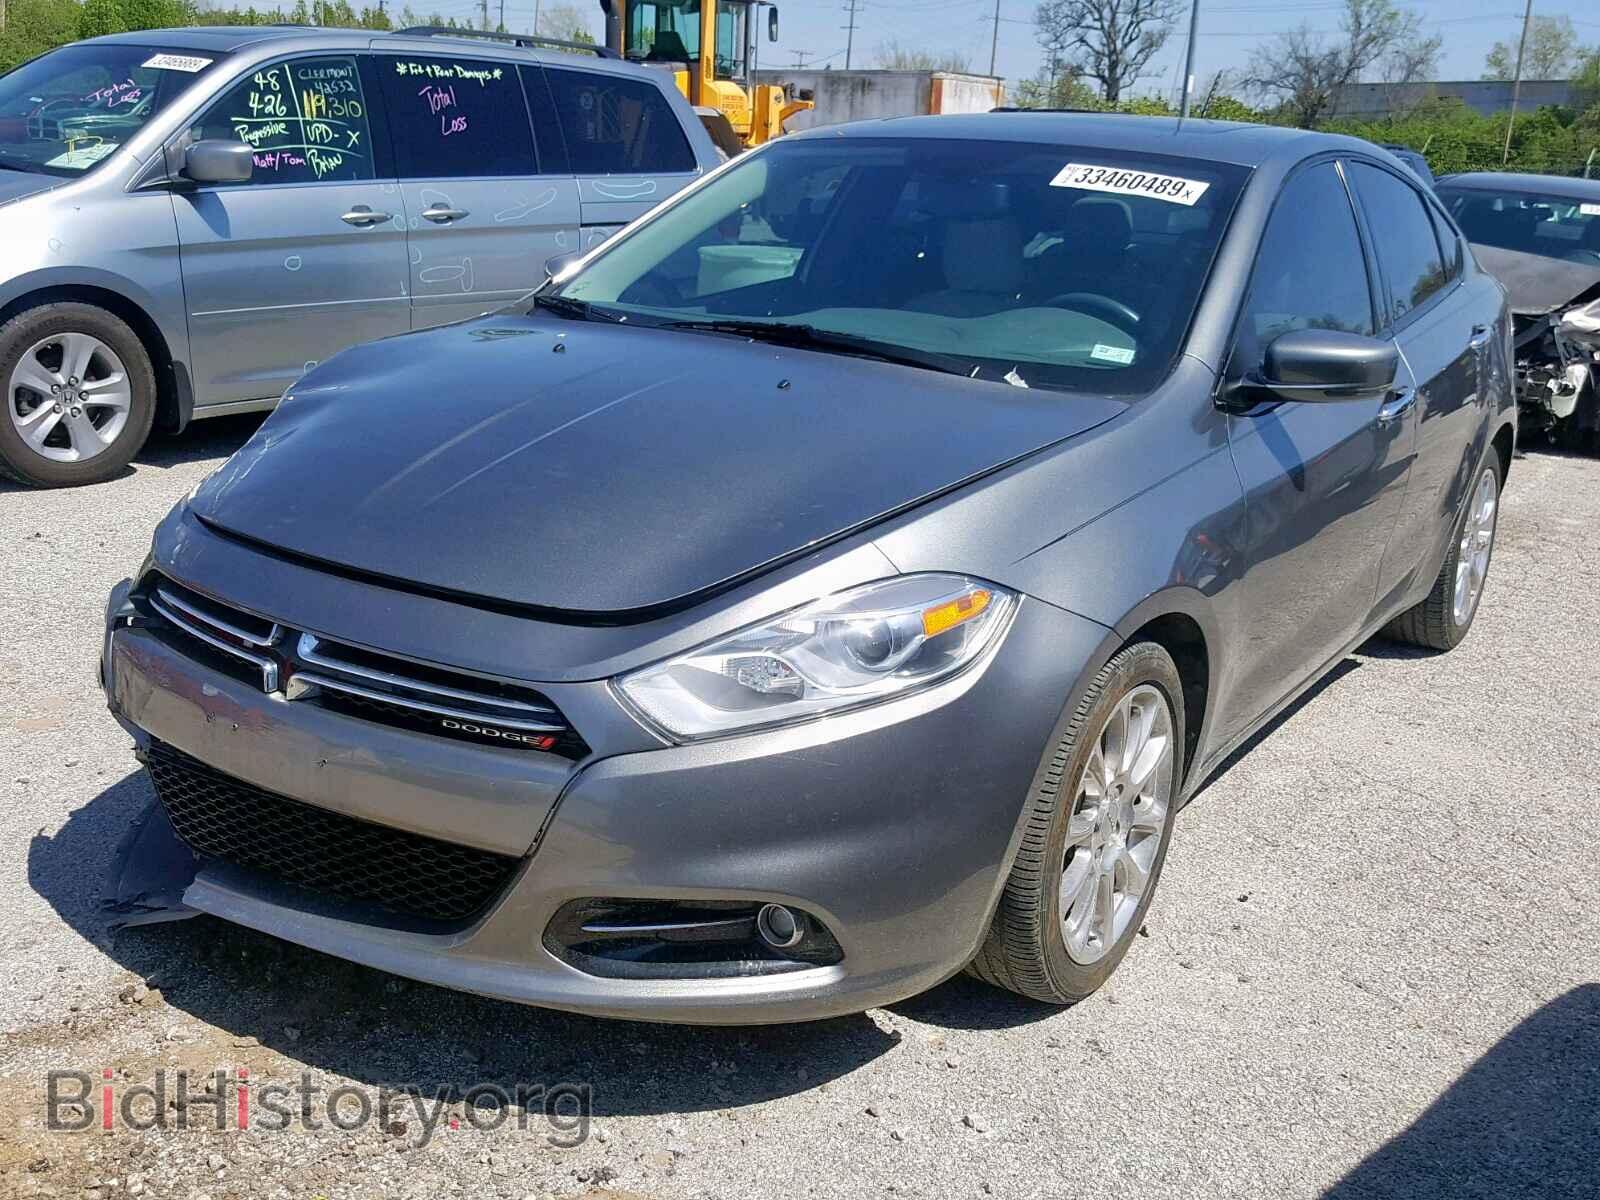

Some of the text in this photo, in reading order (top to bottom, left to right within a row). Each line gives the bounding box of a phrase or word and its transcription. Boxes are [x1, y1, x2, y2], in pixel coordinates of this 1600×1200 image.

[418, 85, 457, 115] Total
[441, 115, 468, 136] Loss
[441, 719, 540, 745] DODGE
